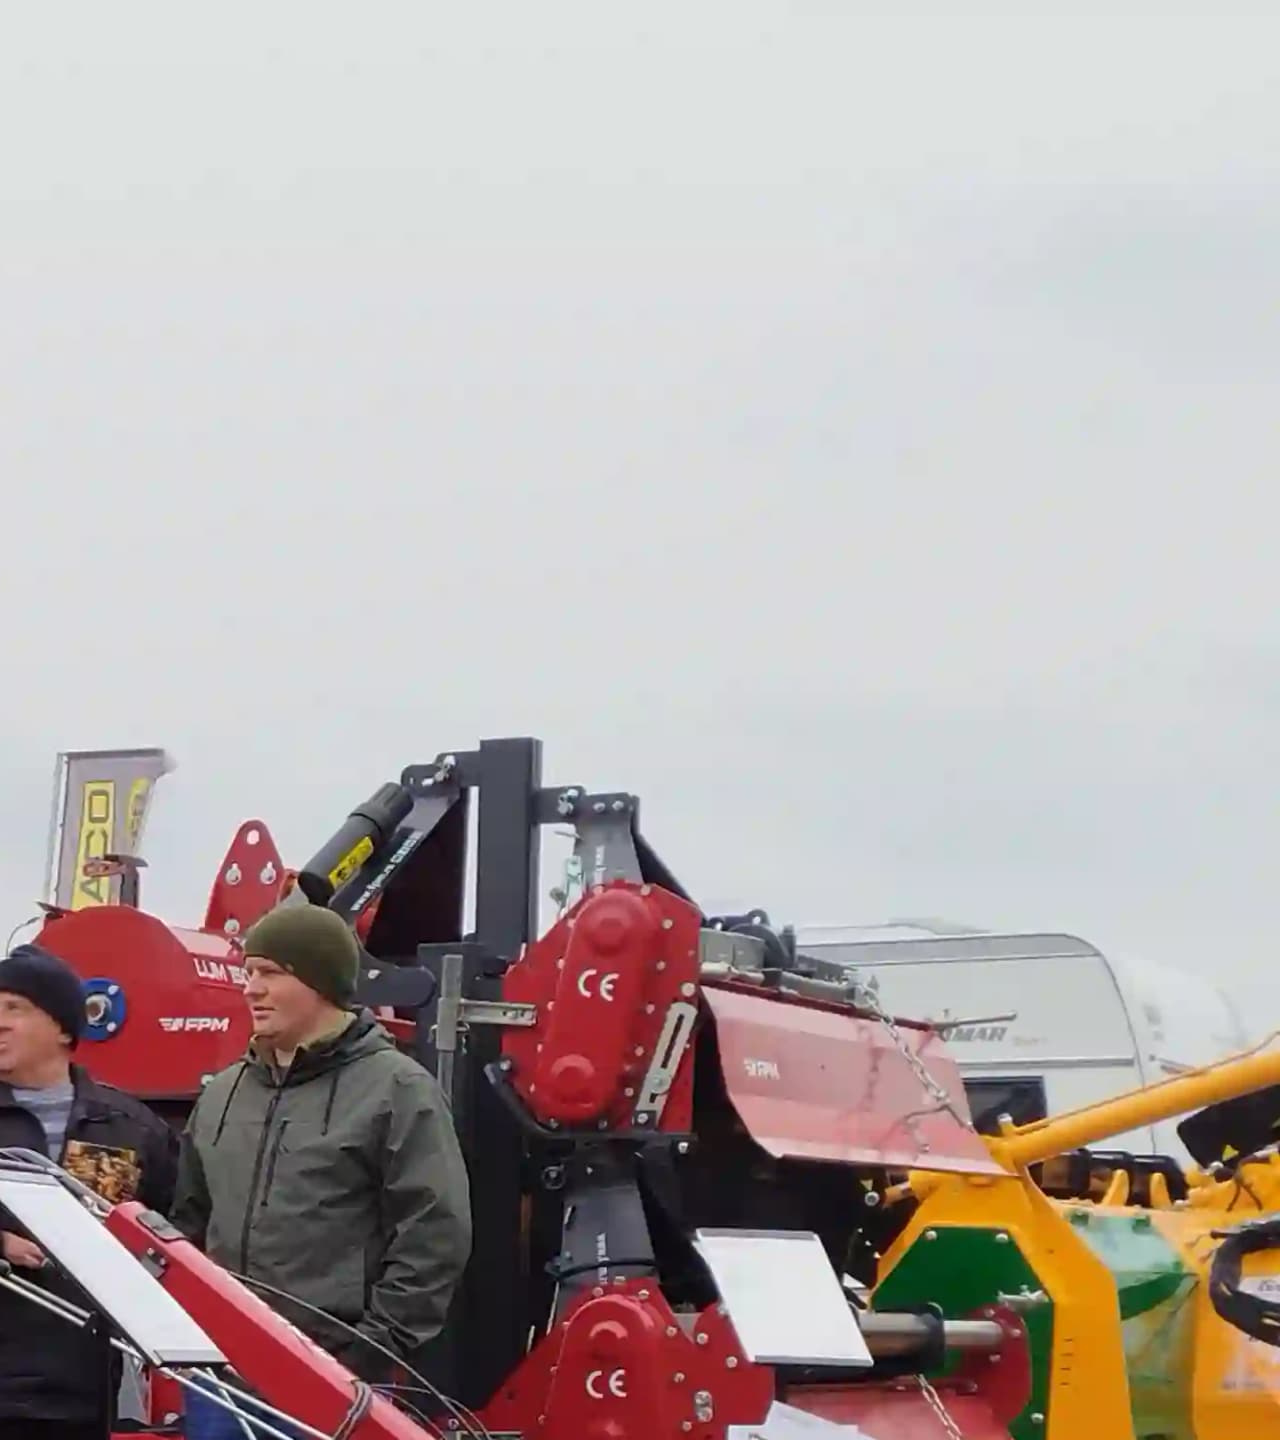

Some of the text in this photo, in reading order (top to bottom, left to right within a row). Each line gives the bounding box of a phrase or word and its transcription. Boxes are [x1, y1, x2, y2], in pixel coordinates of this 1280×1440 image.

[578, 968, 620, 1002] CE
[184, 1016, 230, 1032] FPM
[586, 1369, 628, 1399] CE
